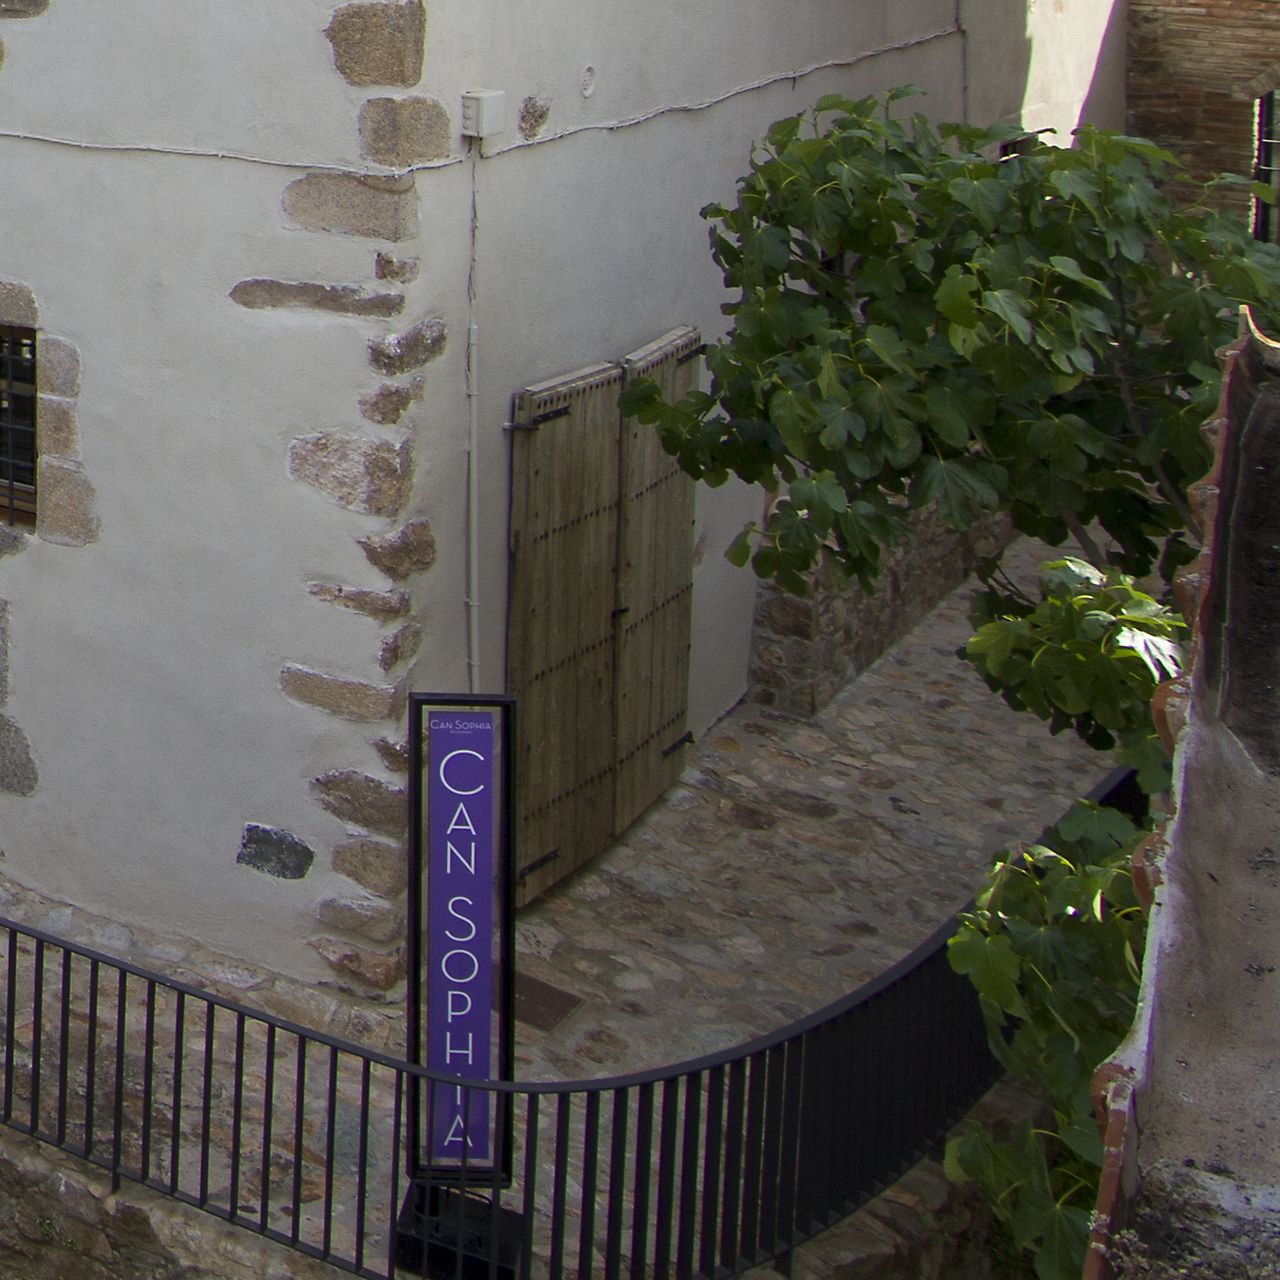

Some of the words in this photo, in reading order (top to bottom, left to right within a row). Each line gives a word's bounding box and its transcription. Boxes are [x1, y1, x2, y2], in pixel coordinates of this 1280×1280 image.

[430, 720, 453, 730] CAN
[455, 720, 492, 730] SOPHIA
[440, 749, 485, 876] CAN
[441, 896, 480, 1148] SOPHIA
